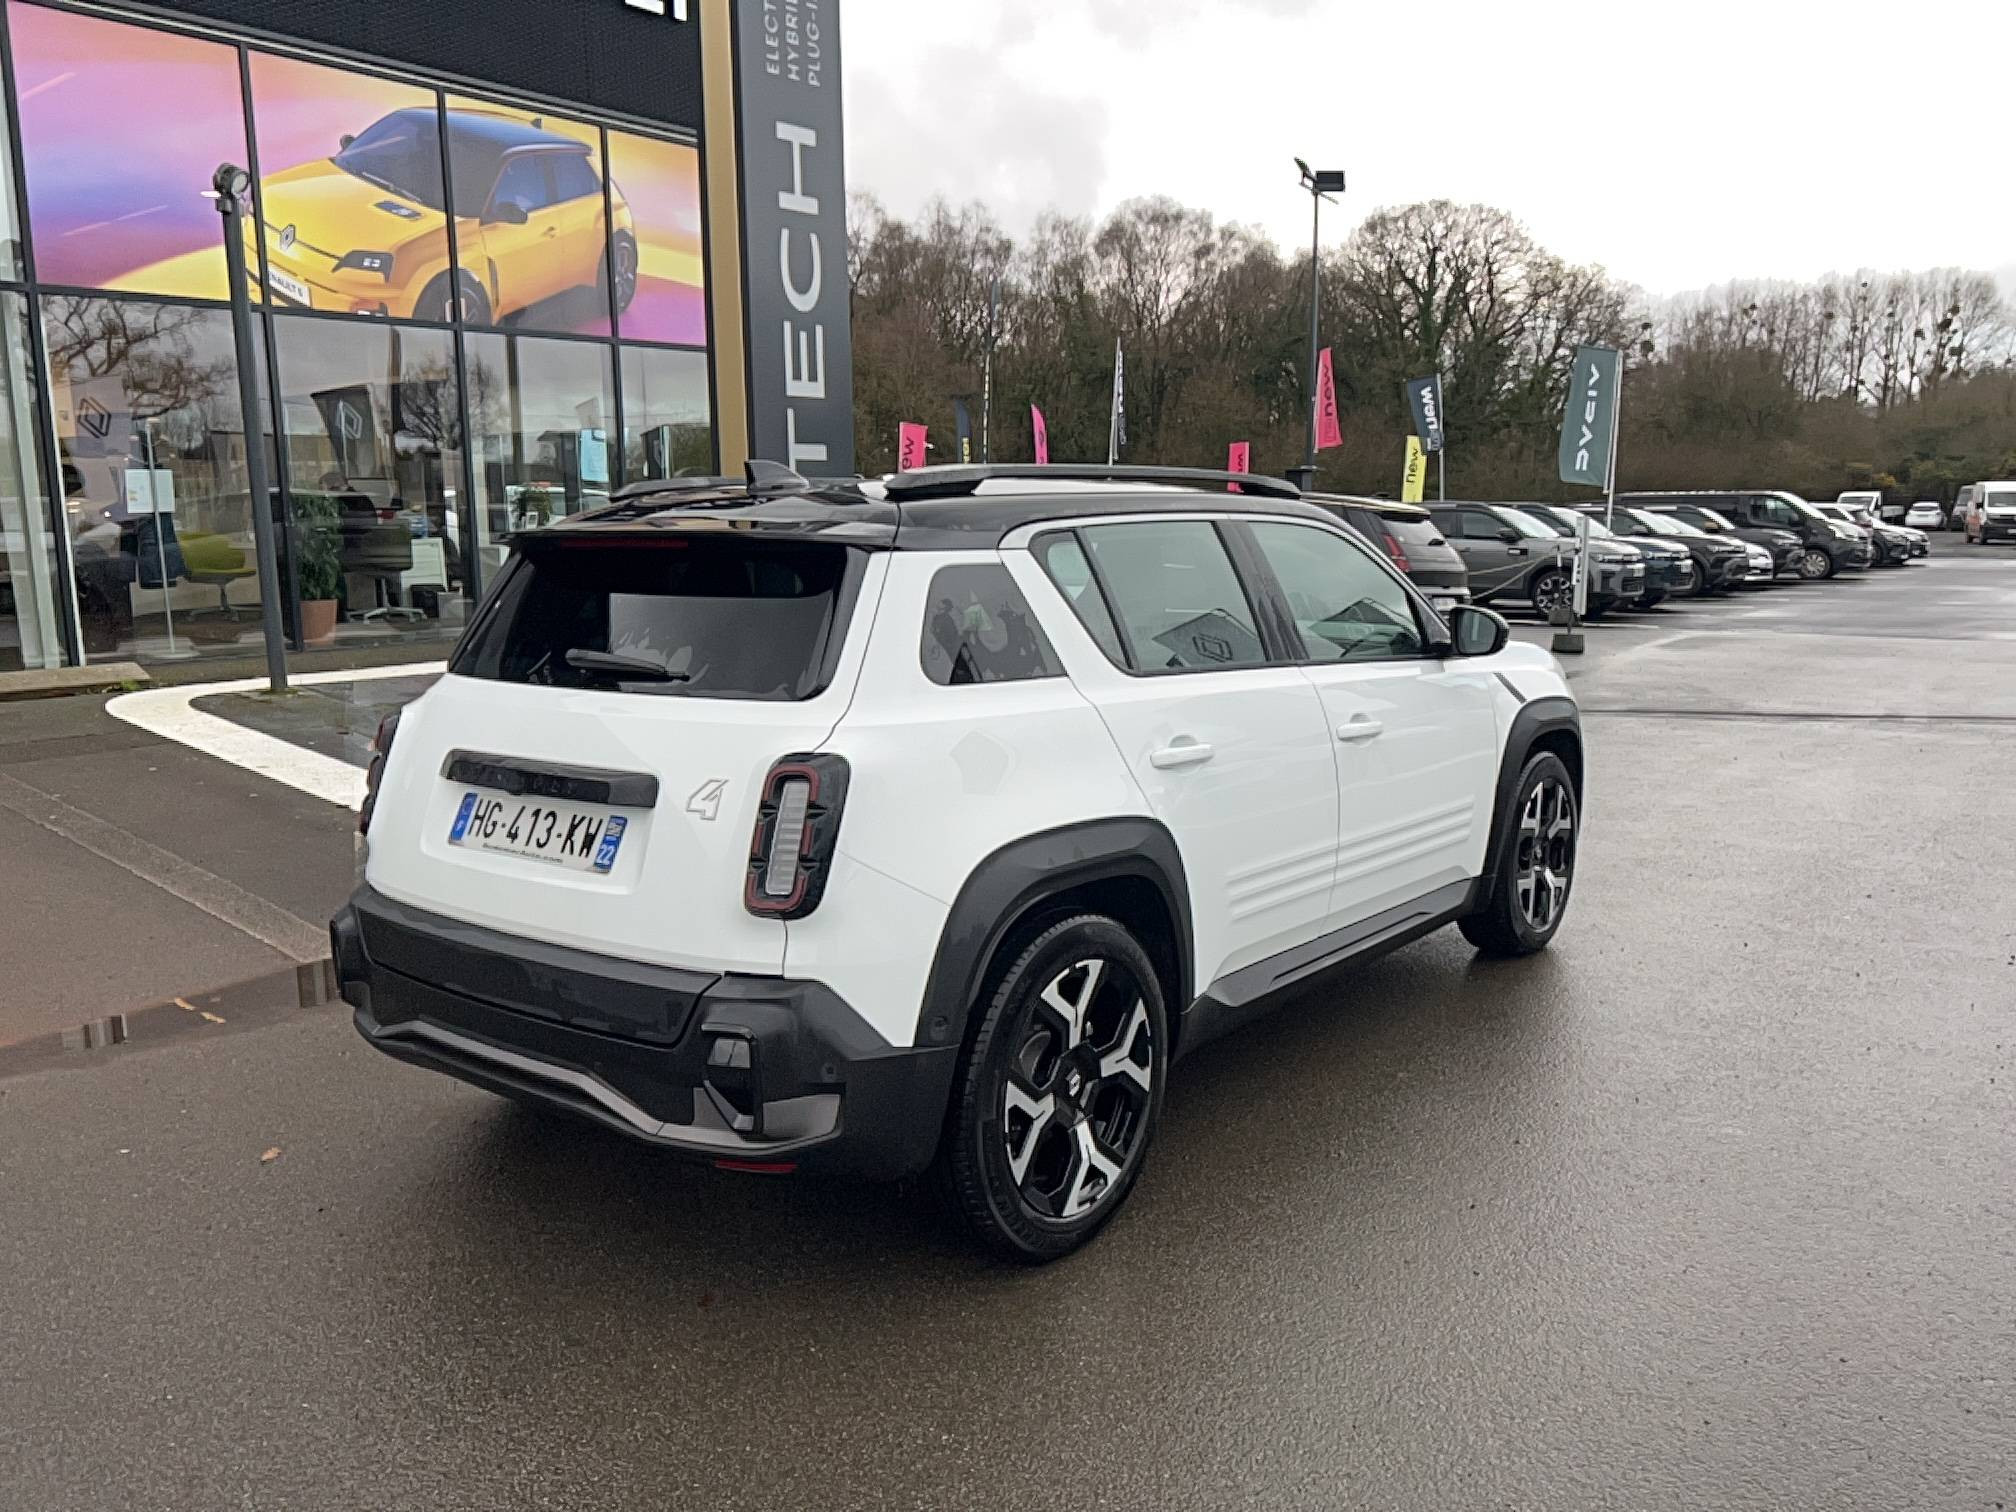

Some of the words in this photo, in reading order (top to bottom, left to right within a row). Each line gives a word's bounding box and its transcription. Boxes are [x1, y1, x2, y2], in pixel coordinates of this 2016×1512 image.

[805, 0, 821, 87] PLUG-I
[1322, 364, 1334, 416] new
[902, 436, 915, 470] ew
[1406, 448, 1419, 484] new
[468, 798, 603, 858] HG-413-KW
[597, 845, 615, 864] 22
